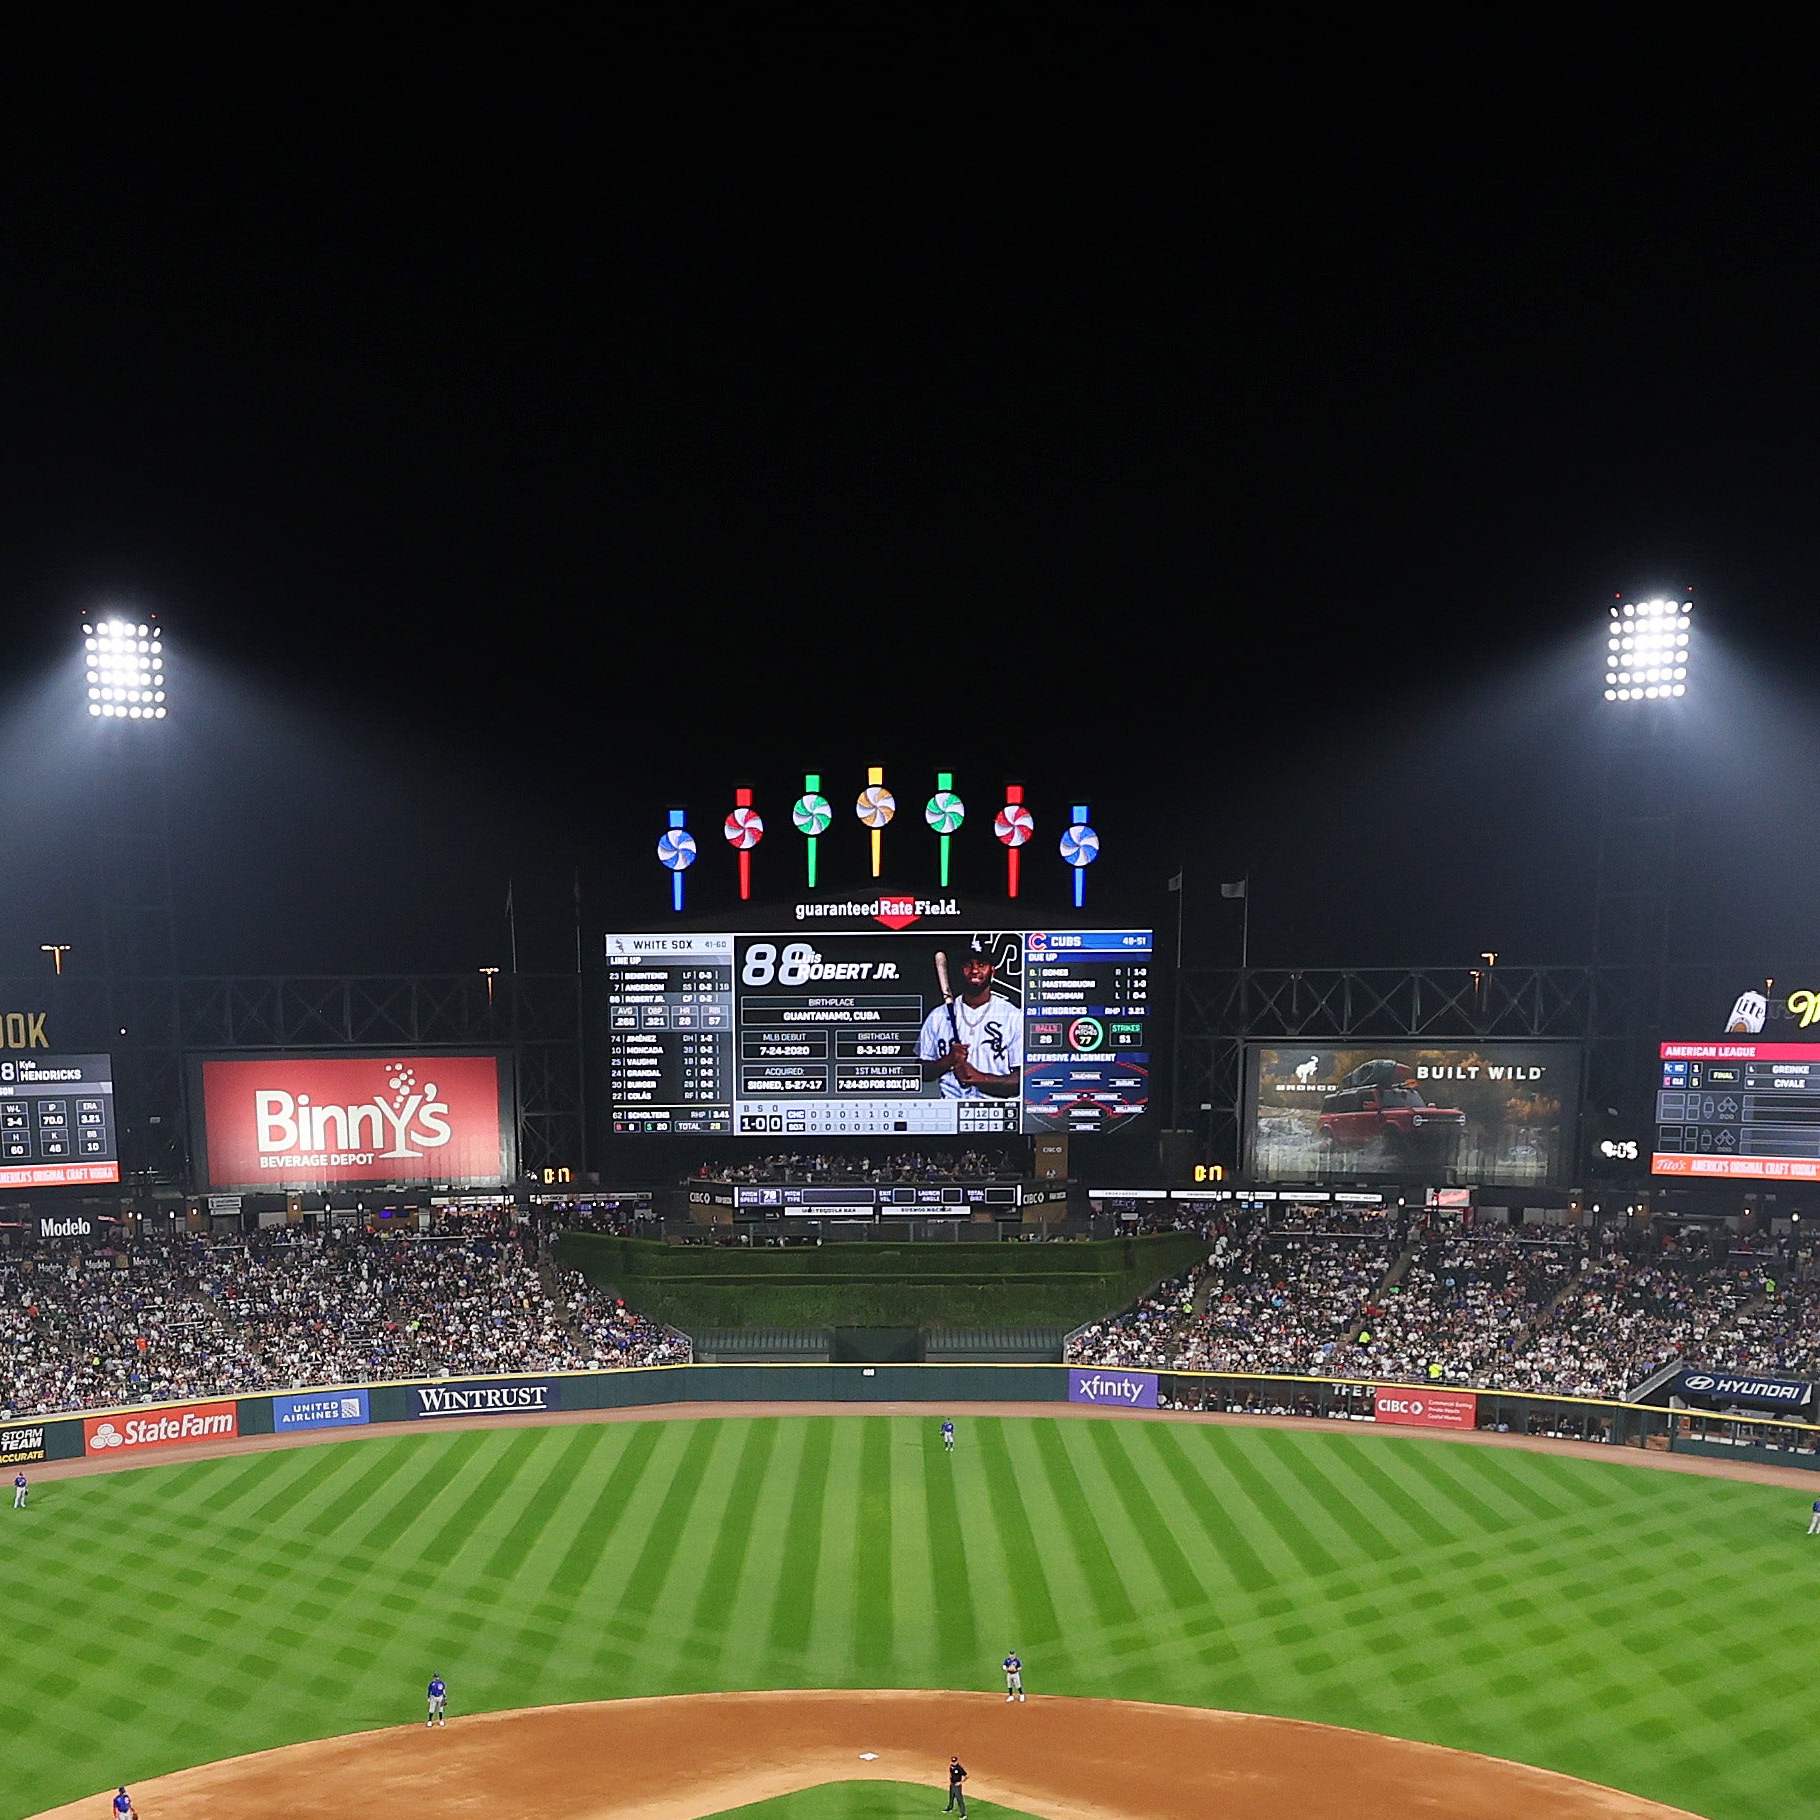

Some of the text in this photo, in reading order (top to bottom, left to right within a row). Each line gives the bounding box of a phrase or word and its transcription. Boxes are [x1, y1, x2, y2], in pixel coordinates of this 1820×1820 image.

[795, 900, 961, 920] guaranteed Rate Field.
[634, 941, 667, 949] WHITE
[672, 940, 693, 949] SOX
[610, 957, 641, 965] LINE UP
[796, 963, 900, 980] ROBERT JR.
[1736, 998, 1765, 1019] Lite
[1665, 1047, 1756, 1057] AMERICAN LEAGUE
[19, 1061, 36, 1070] Kyle
[20, 1070, 81, 1081] HENDRICKS
[1417, 1066, 1542, 1080] BUILT WILD
[260, 1153, 375, 1169] BEVERAGE DEPOT
[40, 1217, 91, 1237] Modelo
[1080, 1377, 1144, 1403] xfinity
[1717, 1378, 1802, 1400] HYUNDAI
[292, 1401, 339, 1413] UNITED
[1378, 1398, 1408, 1415] CIBC
[282, 1410, 340, 1424] AIRLINES
[1, 1427, 44, 1441] STORM
[1, 1437, 44, 1451] TEAM
